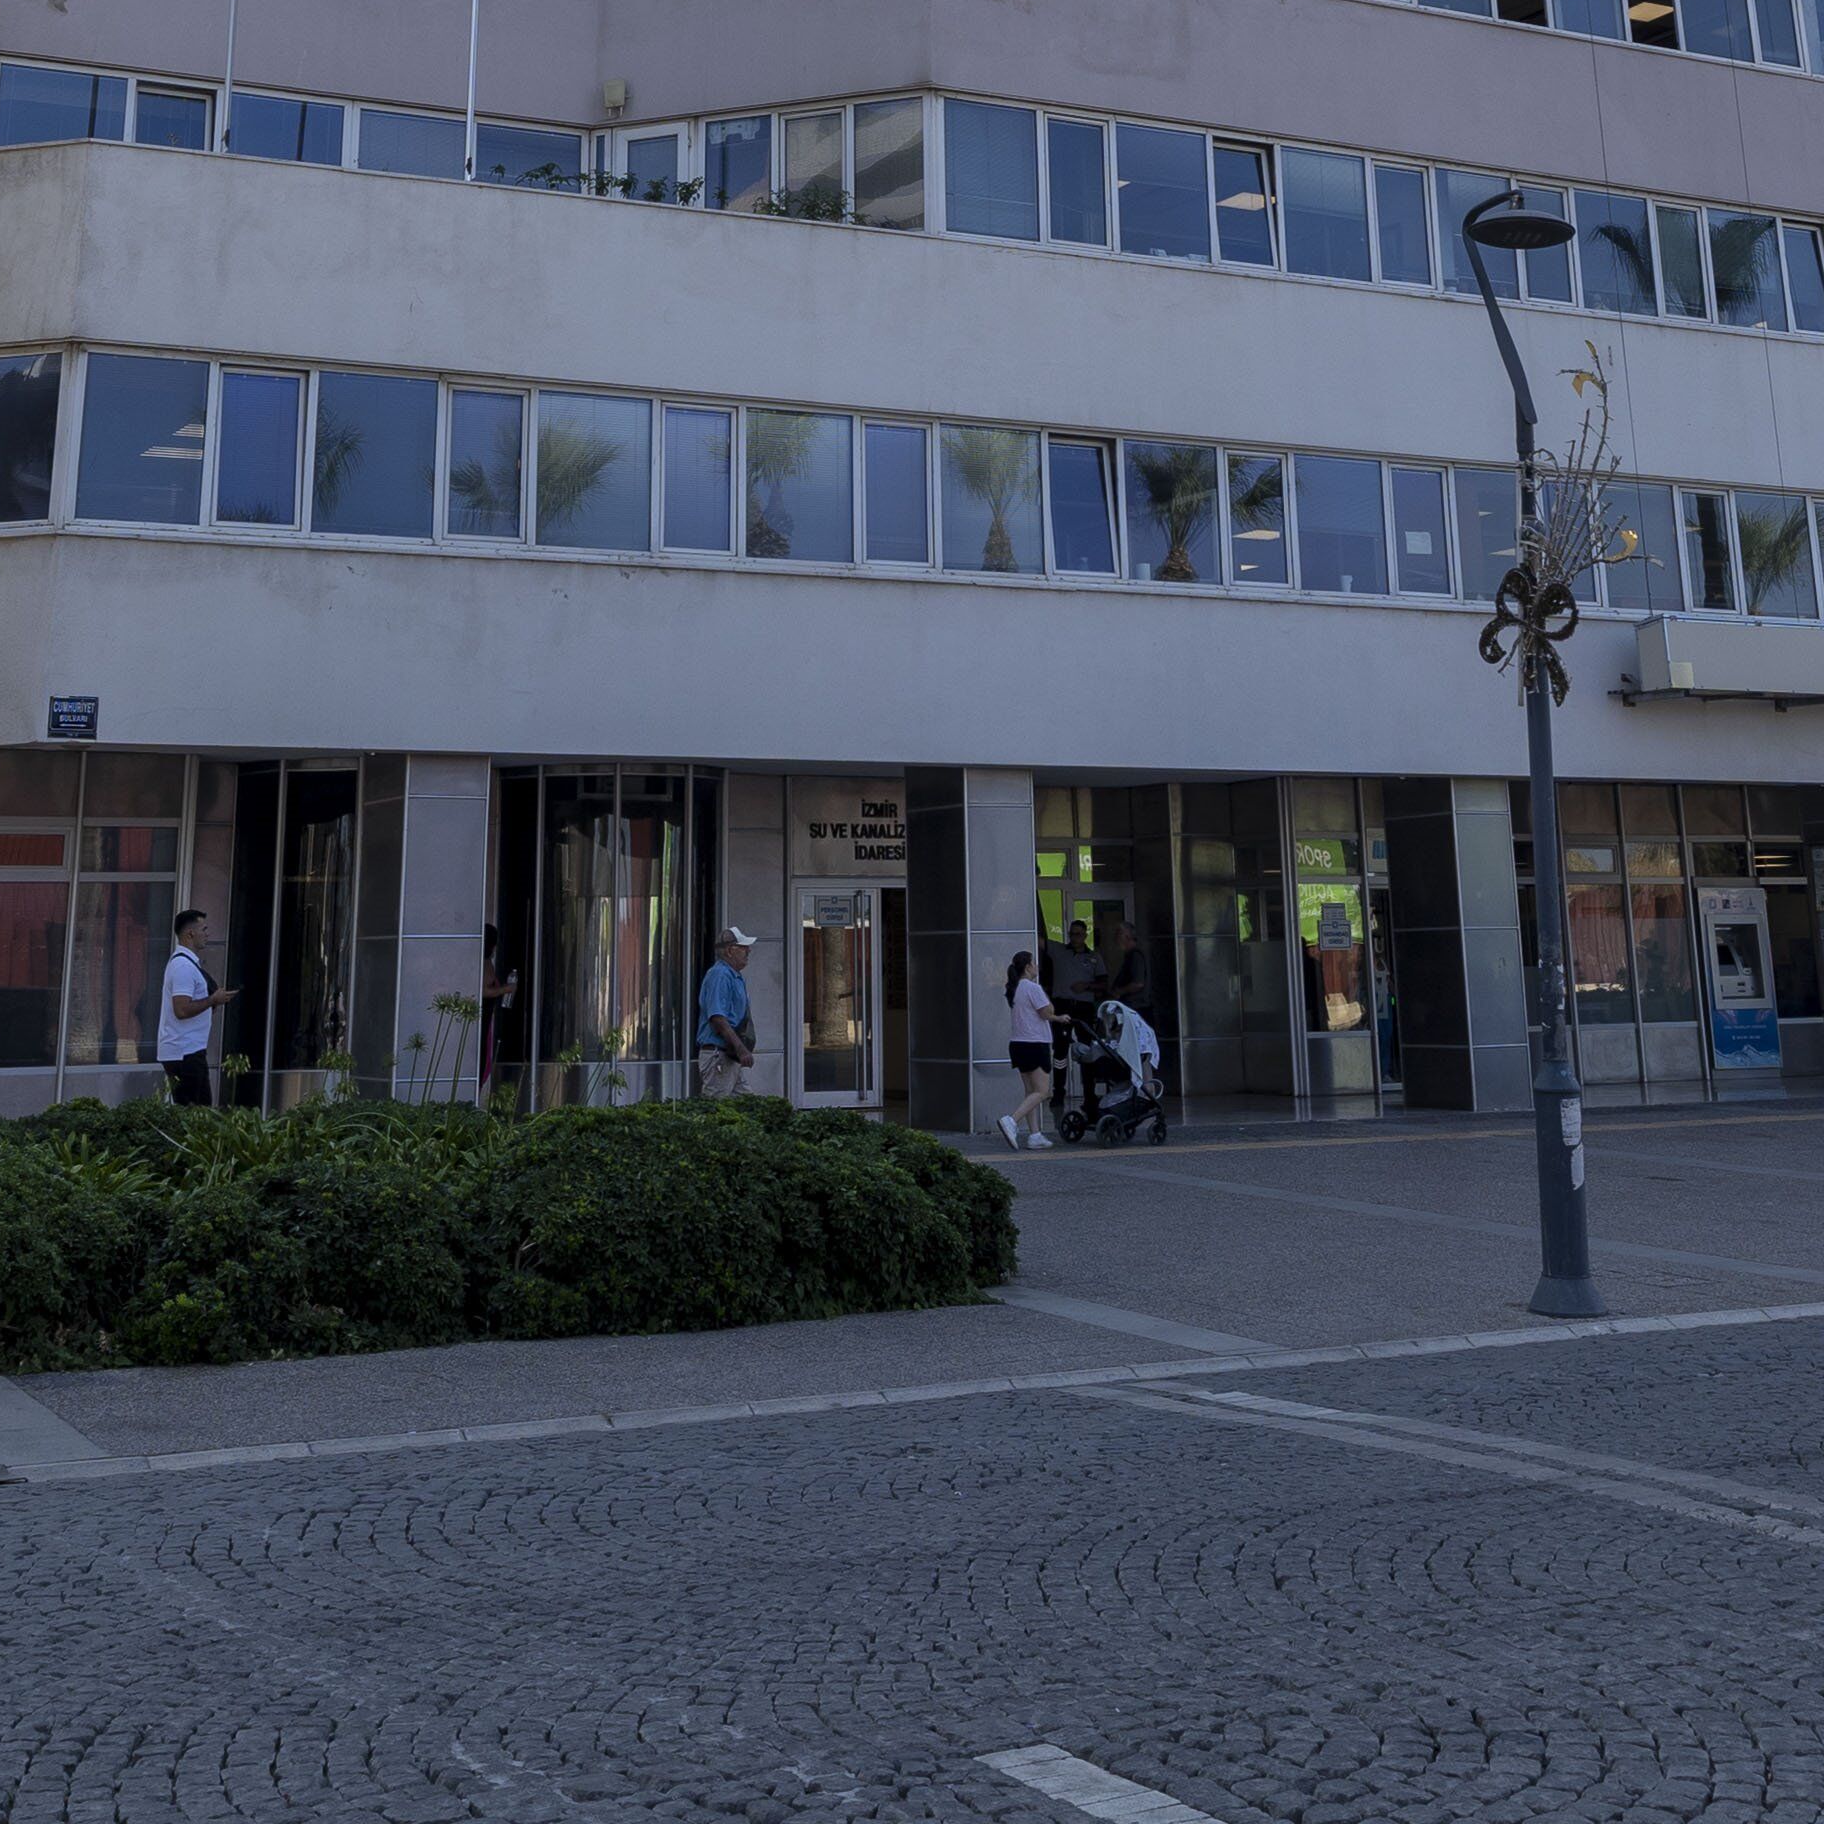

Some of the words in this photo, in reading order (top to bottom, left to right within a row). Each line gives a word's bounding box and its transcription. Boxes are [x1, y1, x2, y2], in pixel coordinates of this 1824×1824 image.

[861, 798, 898, 818] İZMİR
[809, 822, 827, 839] SU
[830, 822, 848, 839] VE
[854, 841, 906, 861] İDARESİ
